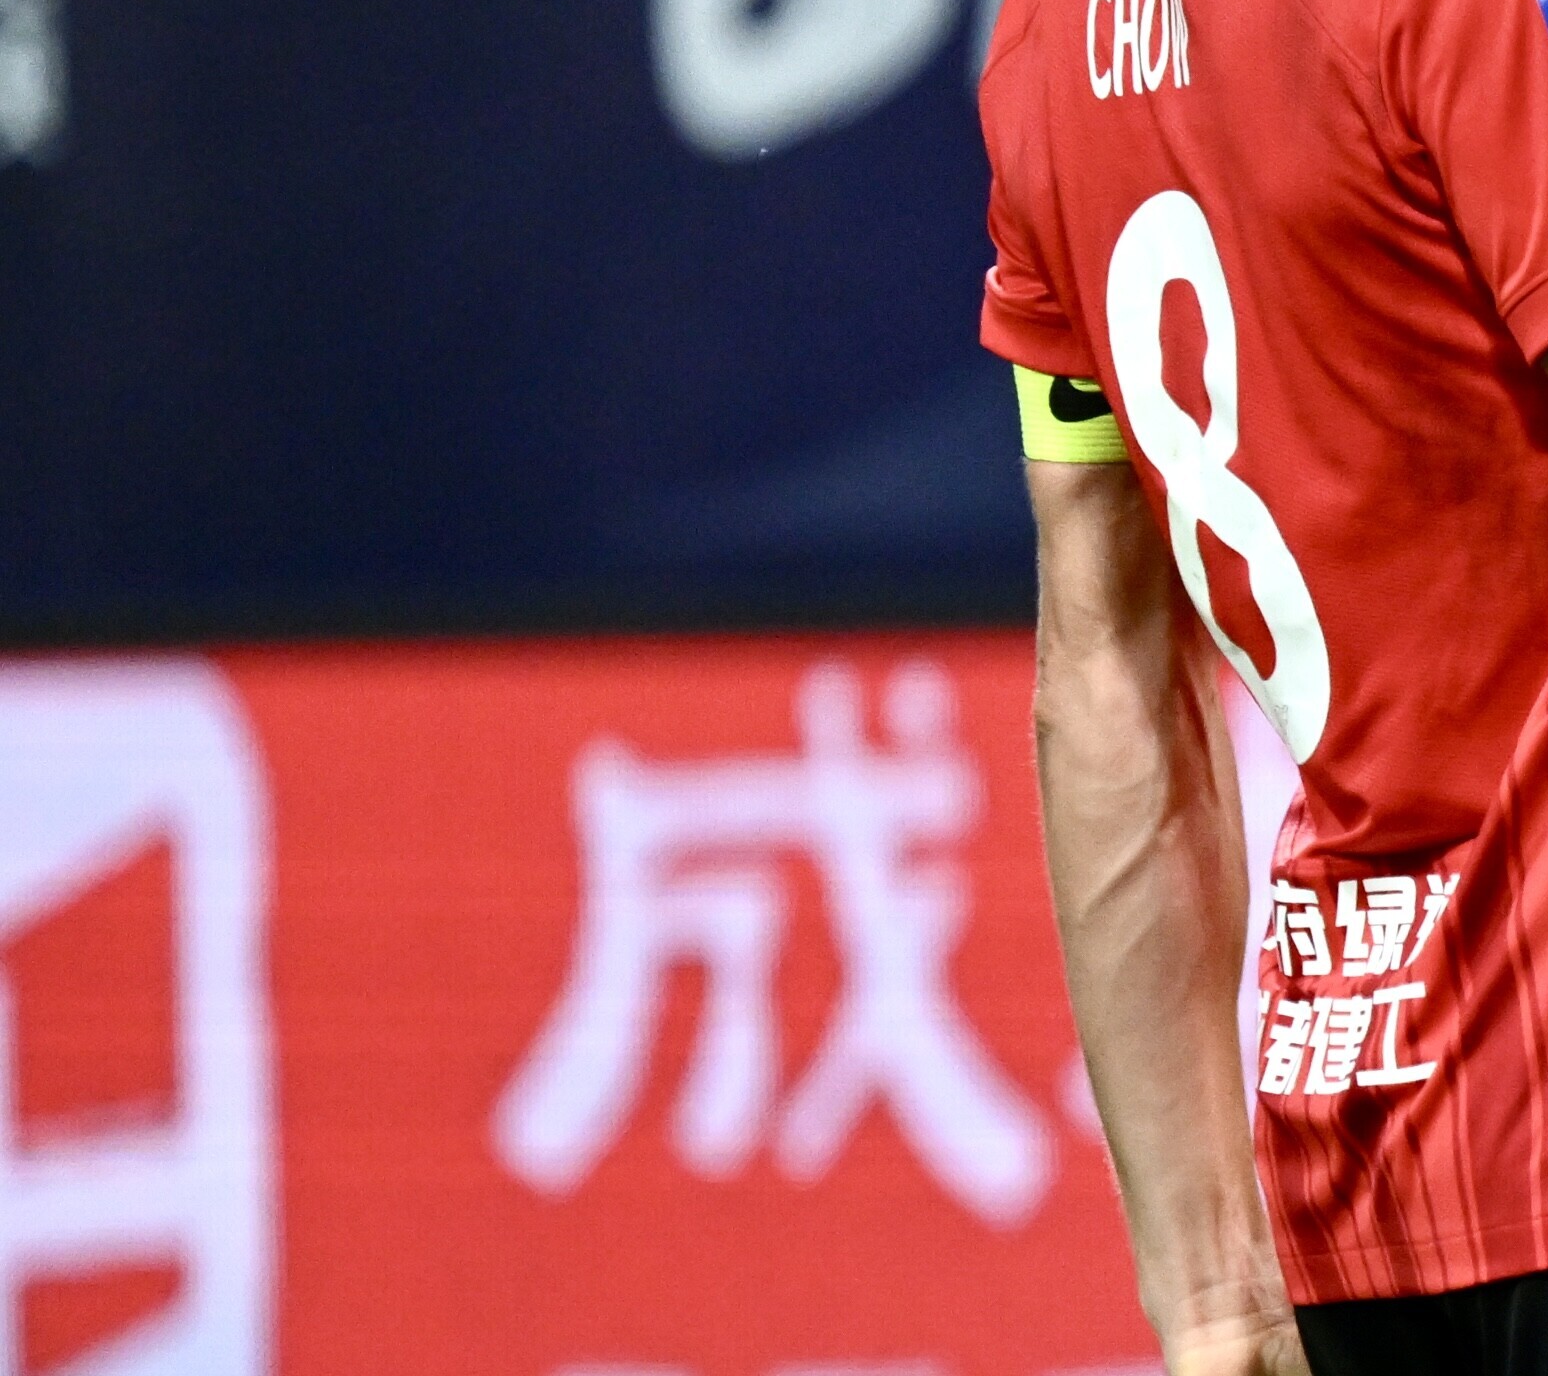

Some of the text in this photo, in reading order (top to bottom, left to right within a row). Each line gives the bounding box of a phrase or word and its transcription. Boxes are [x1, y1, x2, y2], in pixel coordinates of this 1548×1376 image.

[1105, 189, 1331, 765] 8
[1258, 982, 1438, 1095] 都建工
